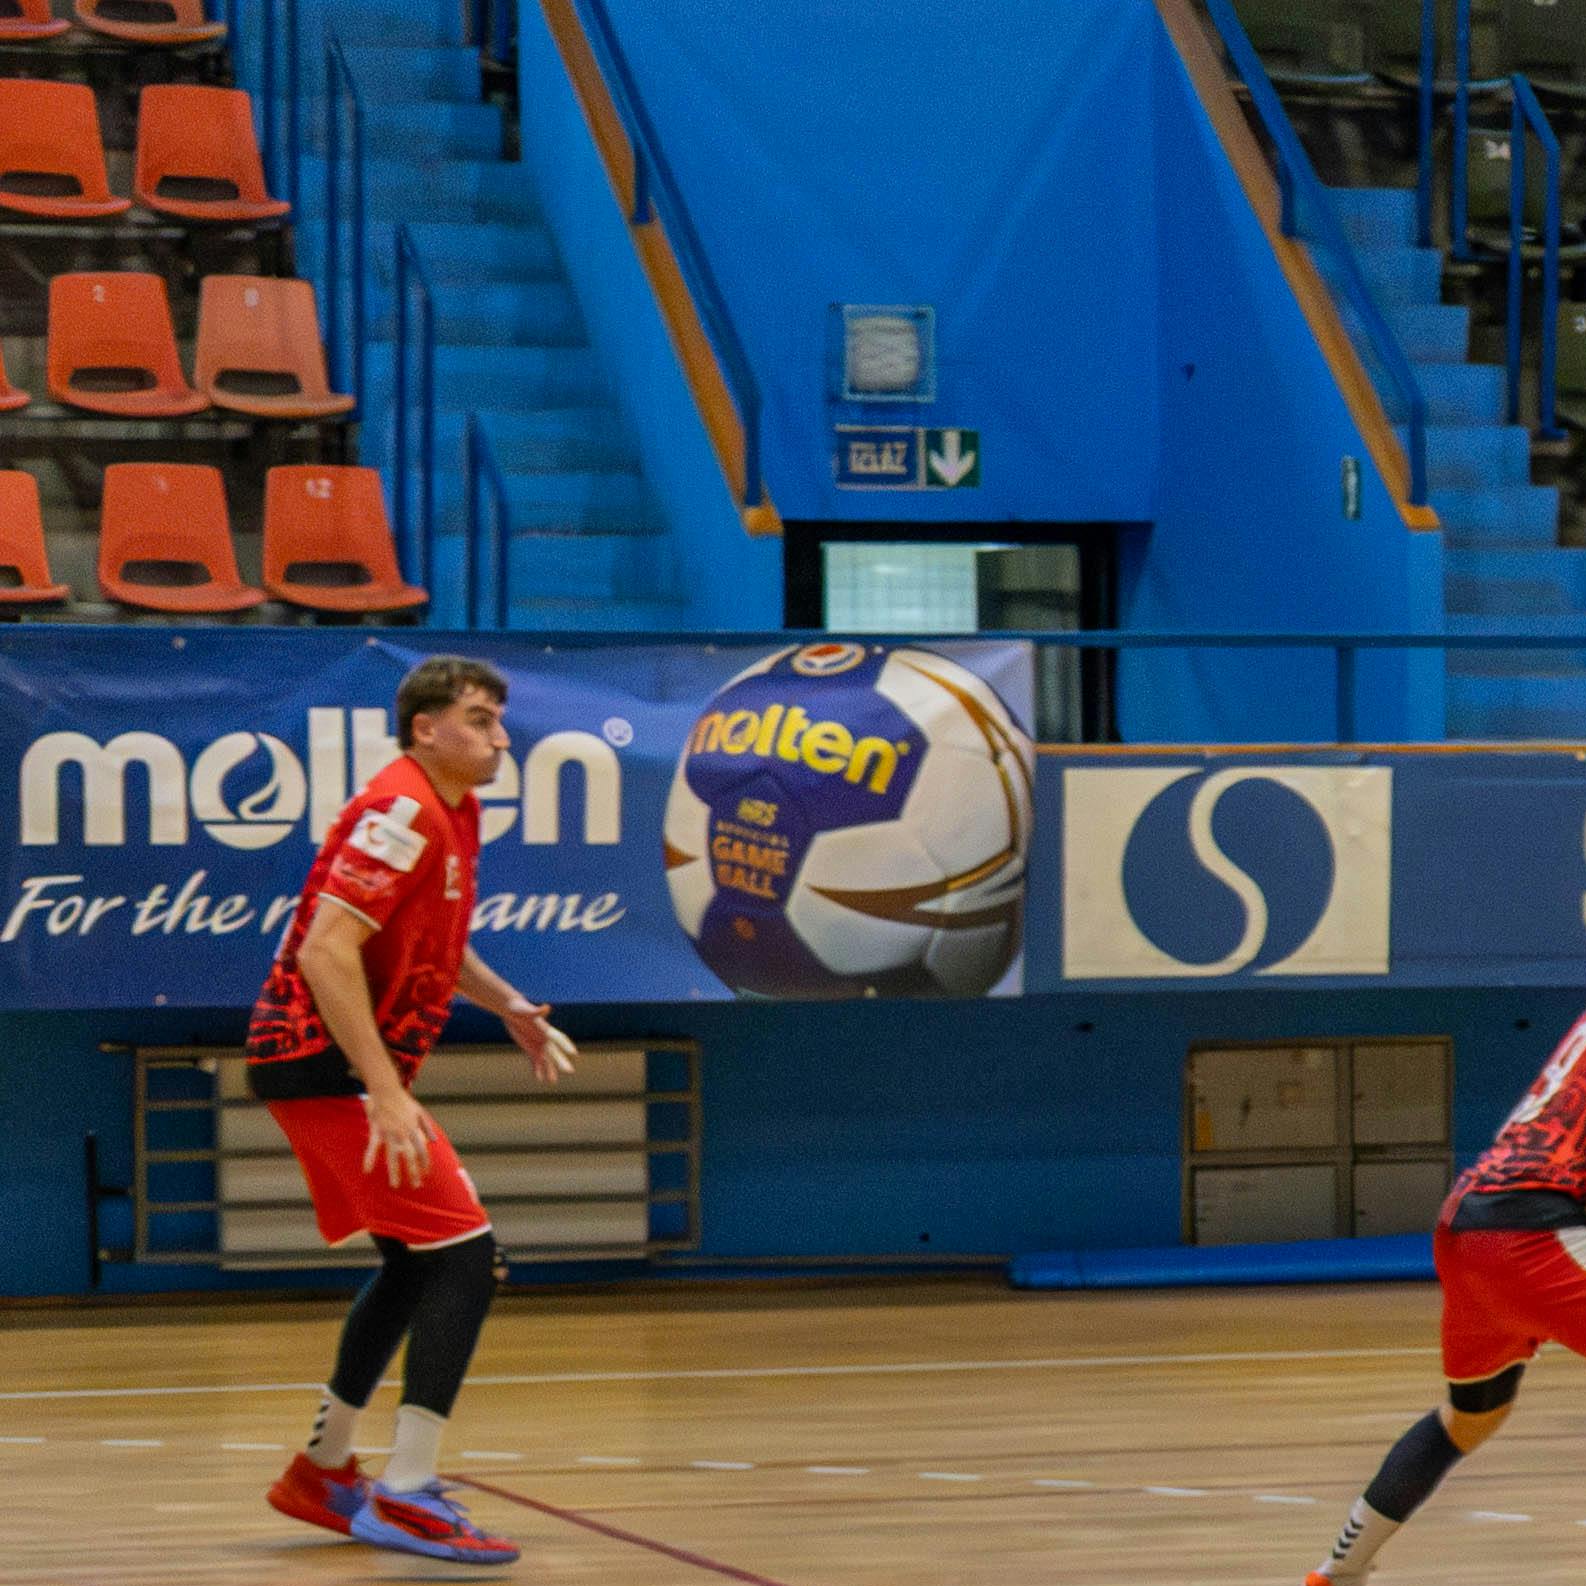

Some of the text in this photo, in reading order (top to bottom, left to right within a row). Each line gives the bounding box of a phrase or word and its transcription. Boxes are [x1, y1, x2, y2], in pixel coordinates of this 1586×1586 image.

[713, 835, 789, 876] GAME
[717, 863, 777, 900] BALL
[0, 869, 628, 943] For the ame
